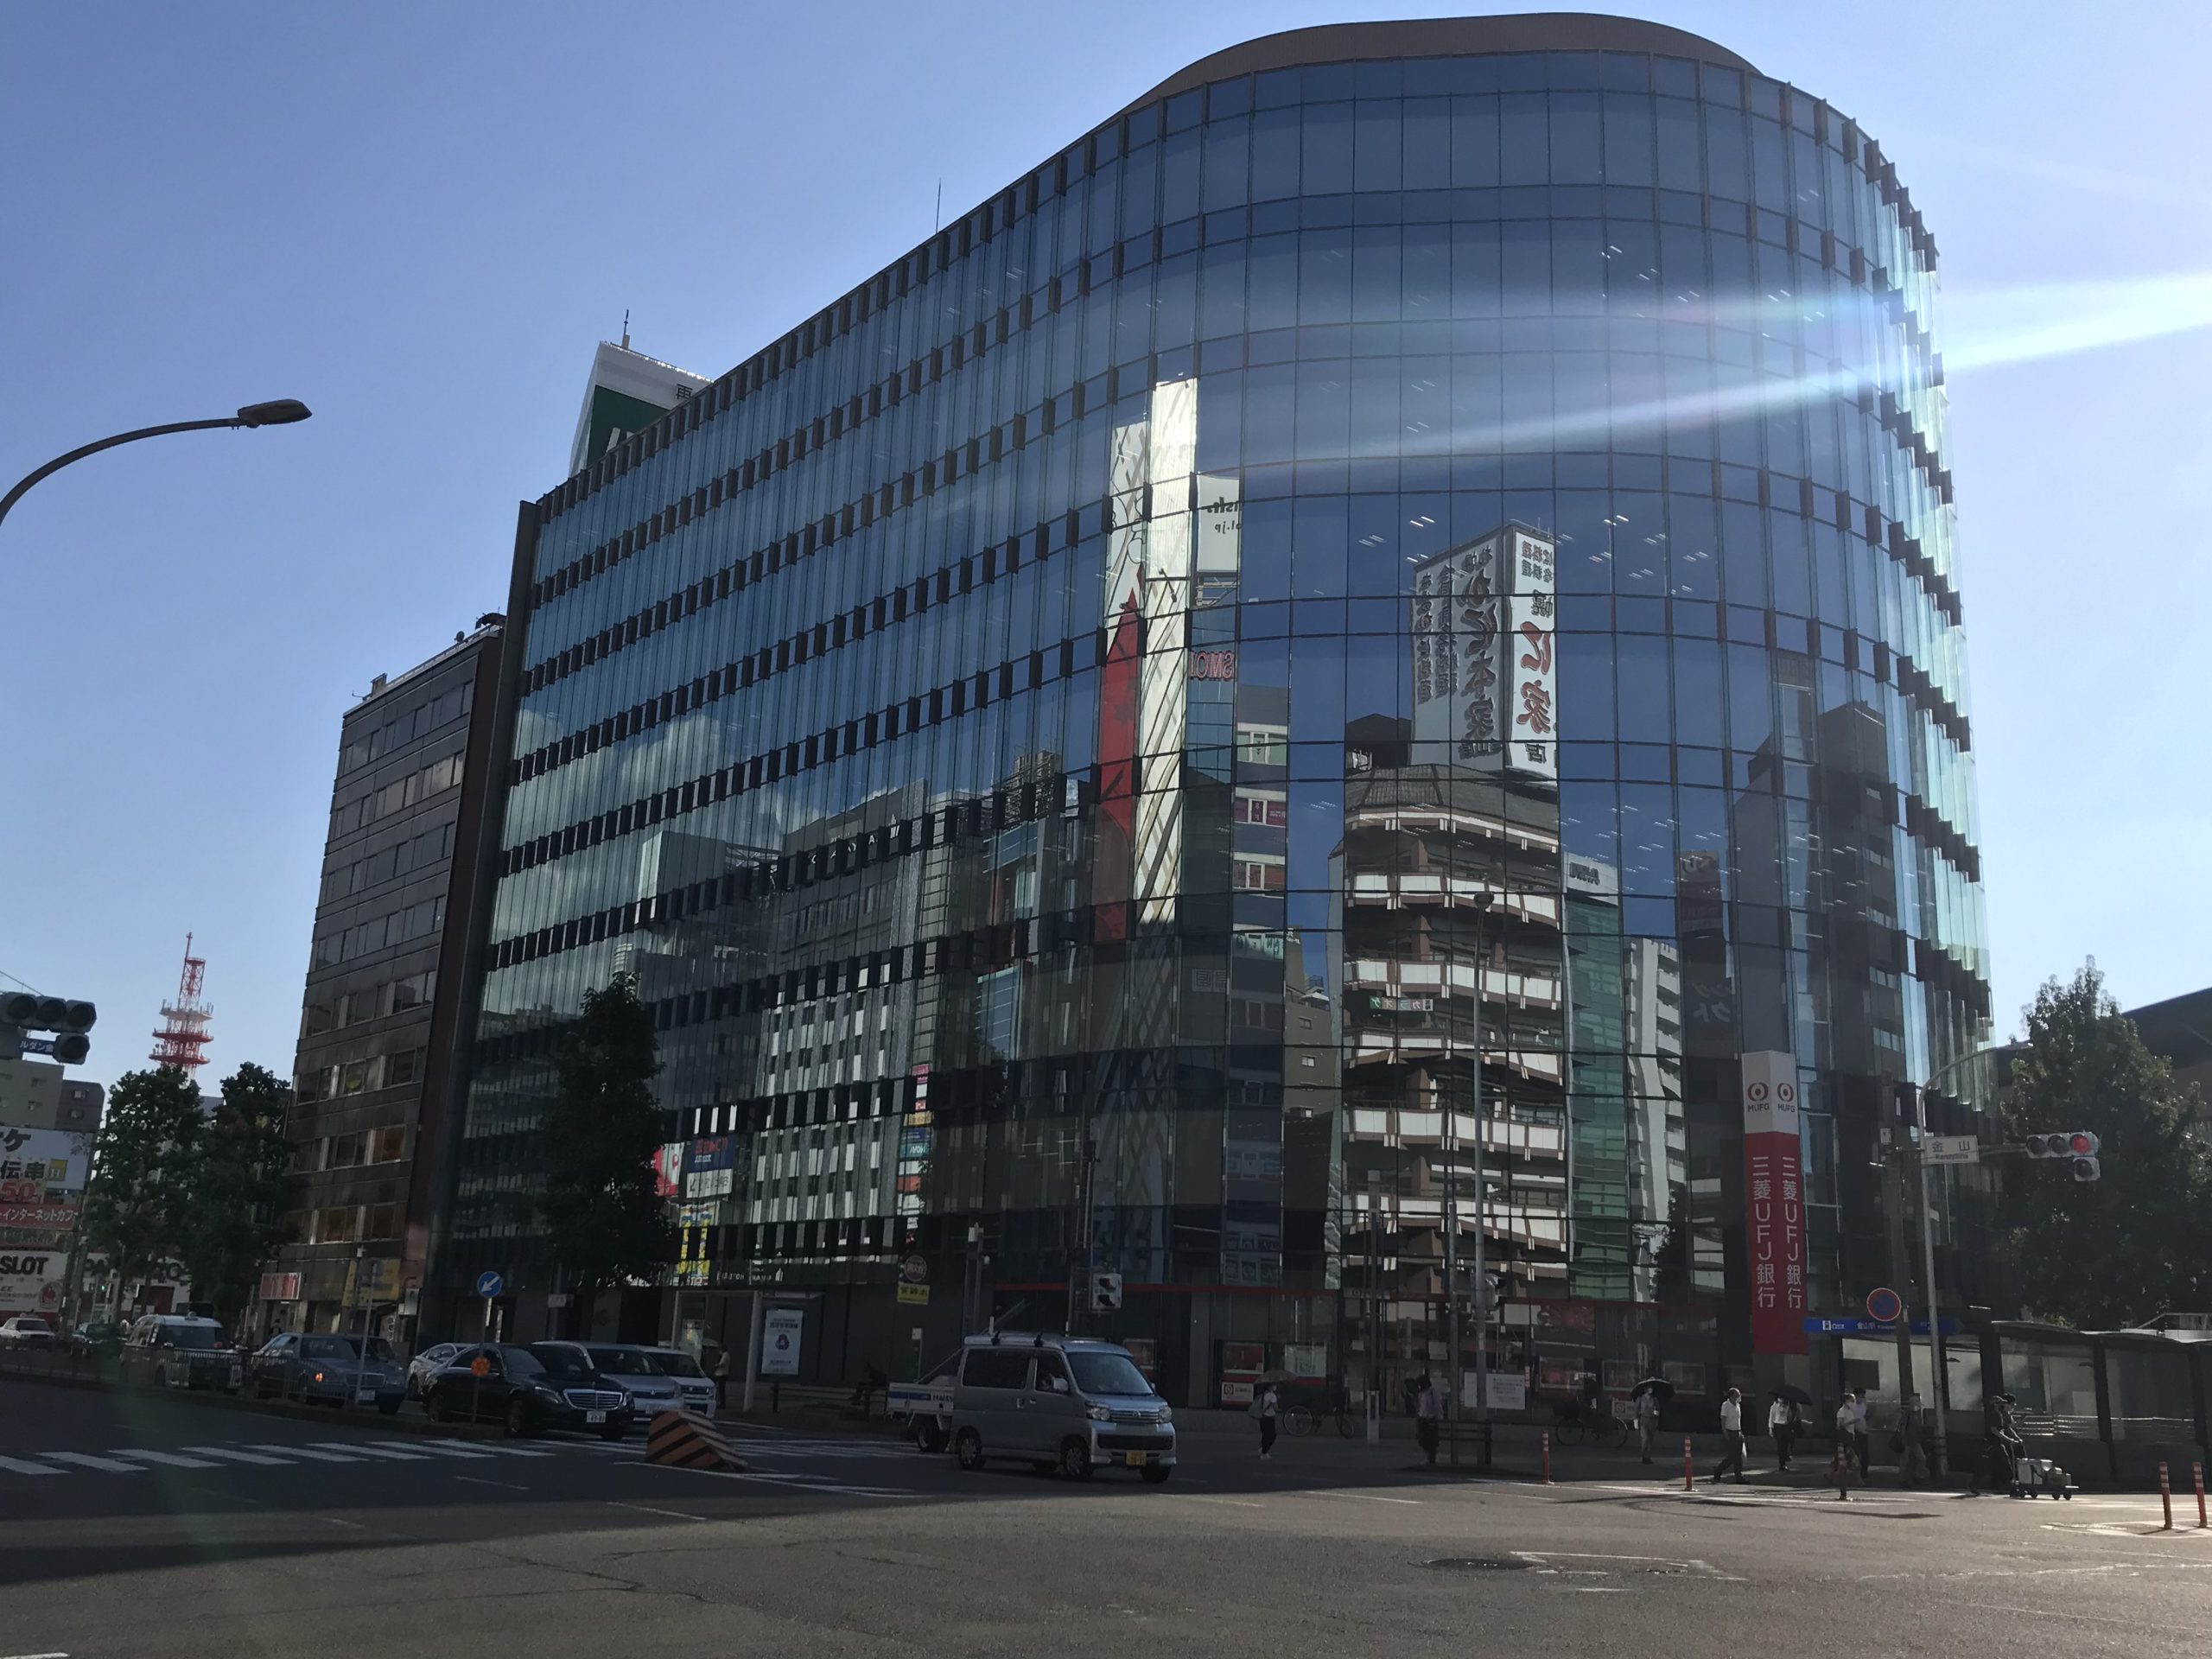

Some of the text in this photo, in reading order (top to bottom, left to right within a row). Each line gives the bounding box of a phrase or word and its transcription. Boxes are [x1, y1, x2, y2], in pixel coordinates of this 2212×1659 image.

[1747, 1102, 1770, 1112] MUFG
[1777, 1102, 1796, 1113] MUFG
[0, 1128, 32, 1152] ケ
[1932, 1141, 1970, 1153] 金山
[1751, 1155, 1776, 1309] 三菱UFJ銀行
[1782, 1155, 1802, 1310] 三菱UFJ銀行
[0, 1255, 48, 1275] SLOT
